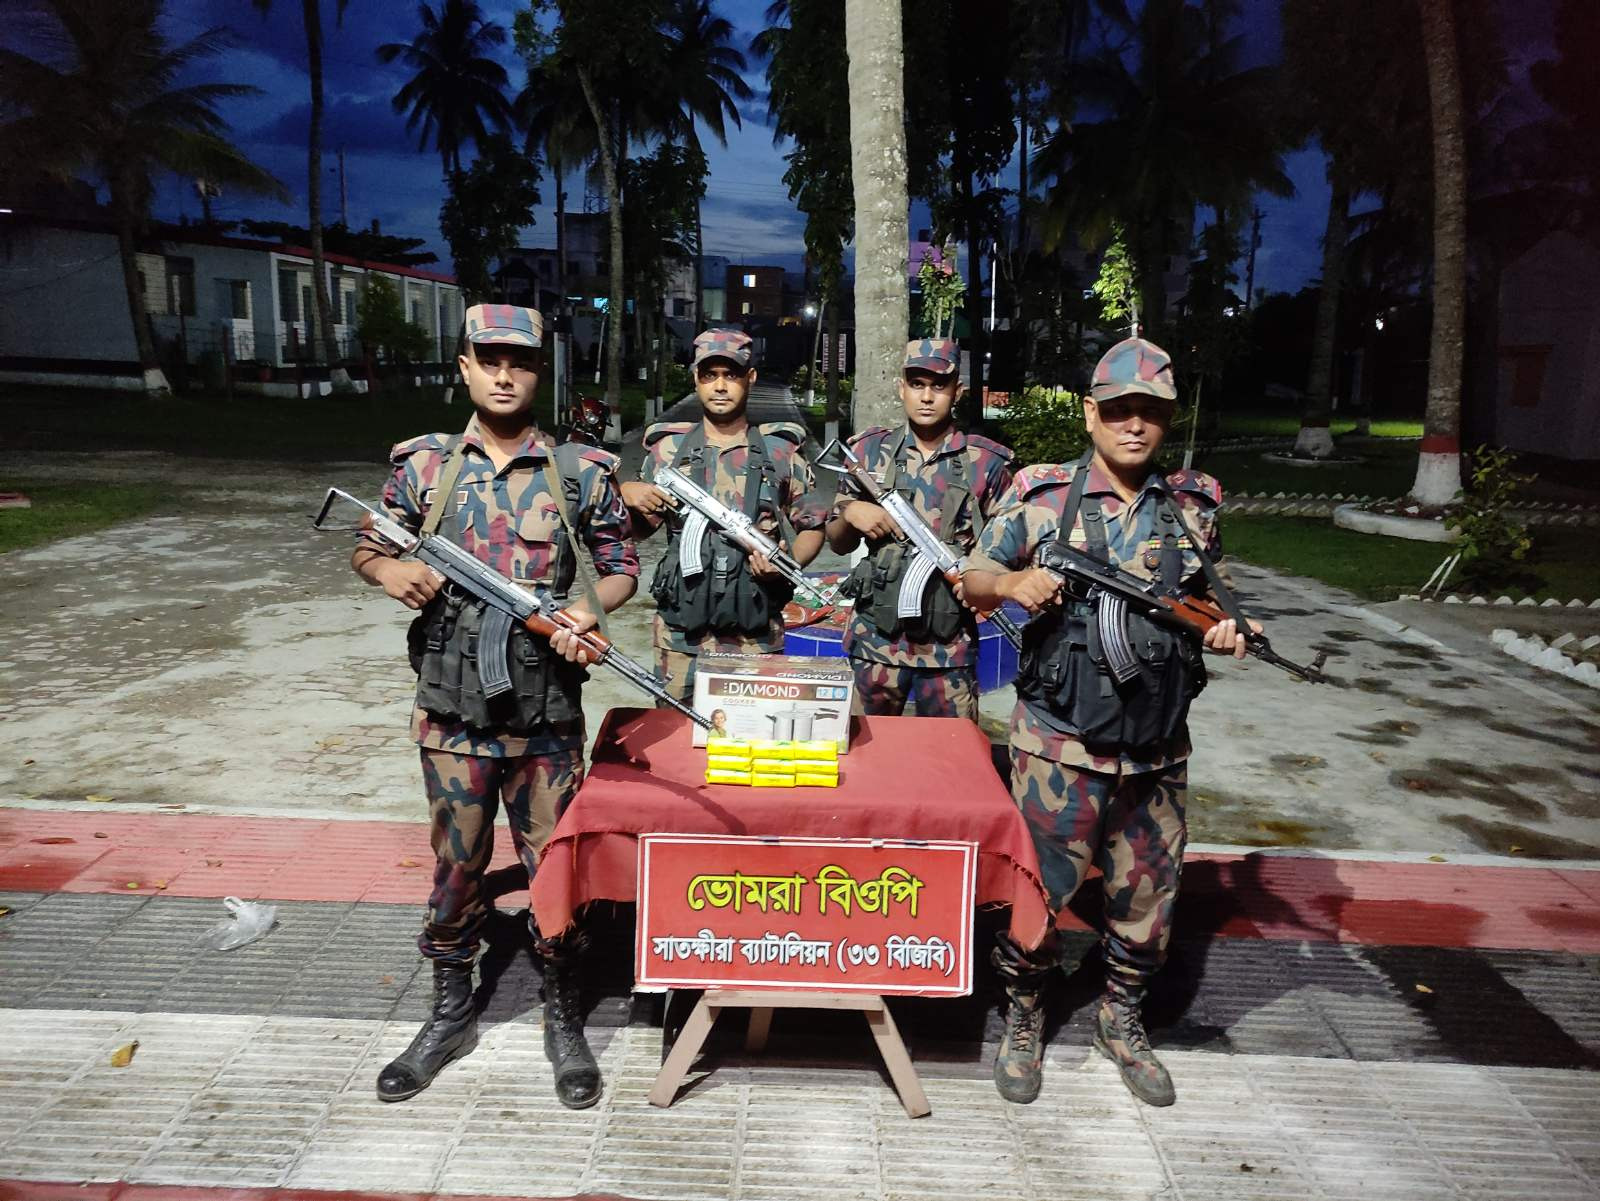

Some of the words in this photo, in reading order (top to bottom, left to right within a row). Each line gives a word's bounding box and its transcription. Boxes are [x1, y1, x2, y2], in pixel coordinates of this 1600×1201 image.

[728, 681, 800, 698] DIAMOND
[687, 870, 808, 914] ভোমরা
[815, 864, 924, 918] বিওপি
[652, 928, 735, 963] সাতক্ষীরা
[739, 931, 833, 967] ব্যাটালিয়ন
[885, 935, 956, 976] বিজিবি)
